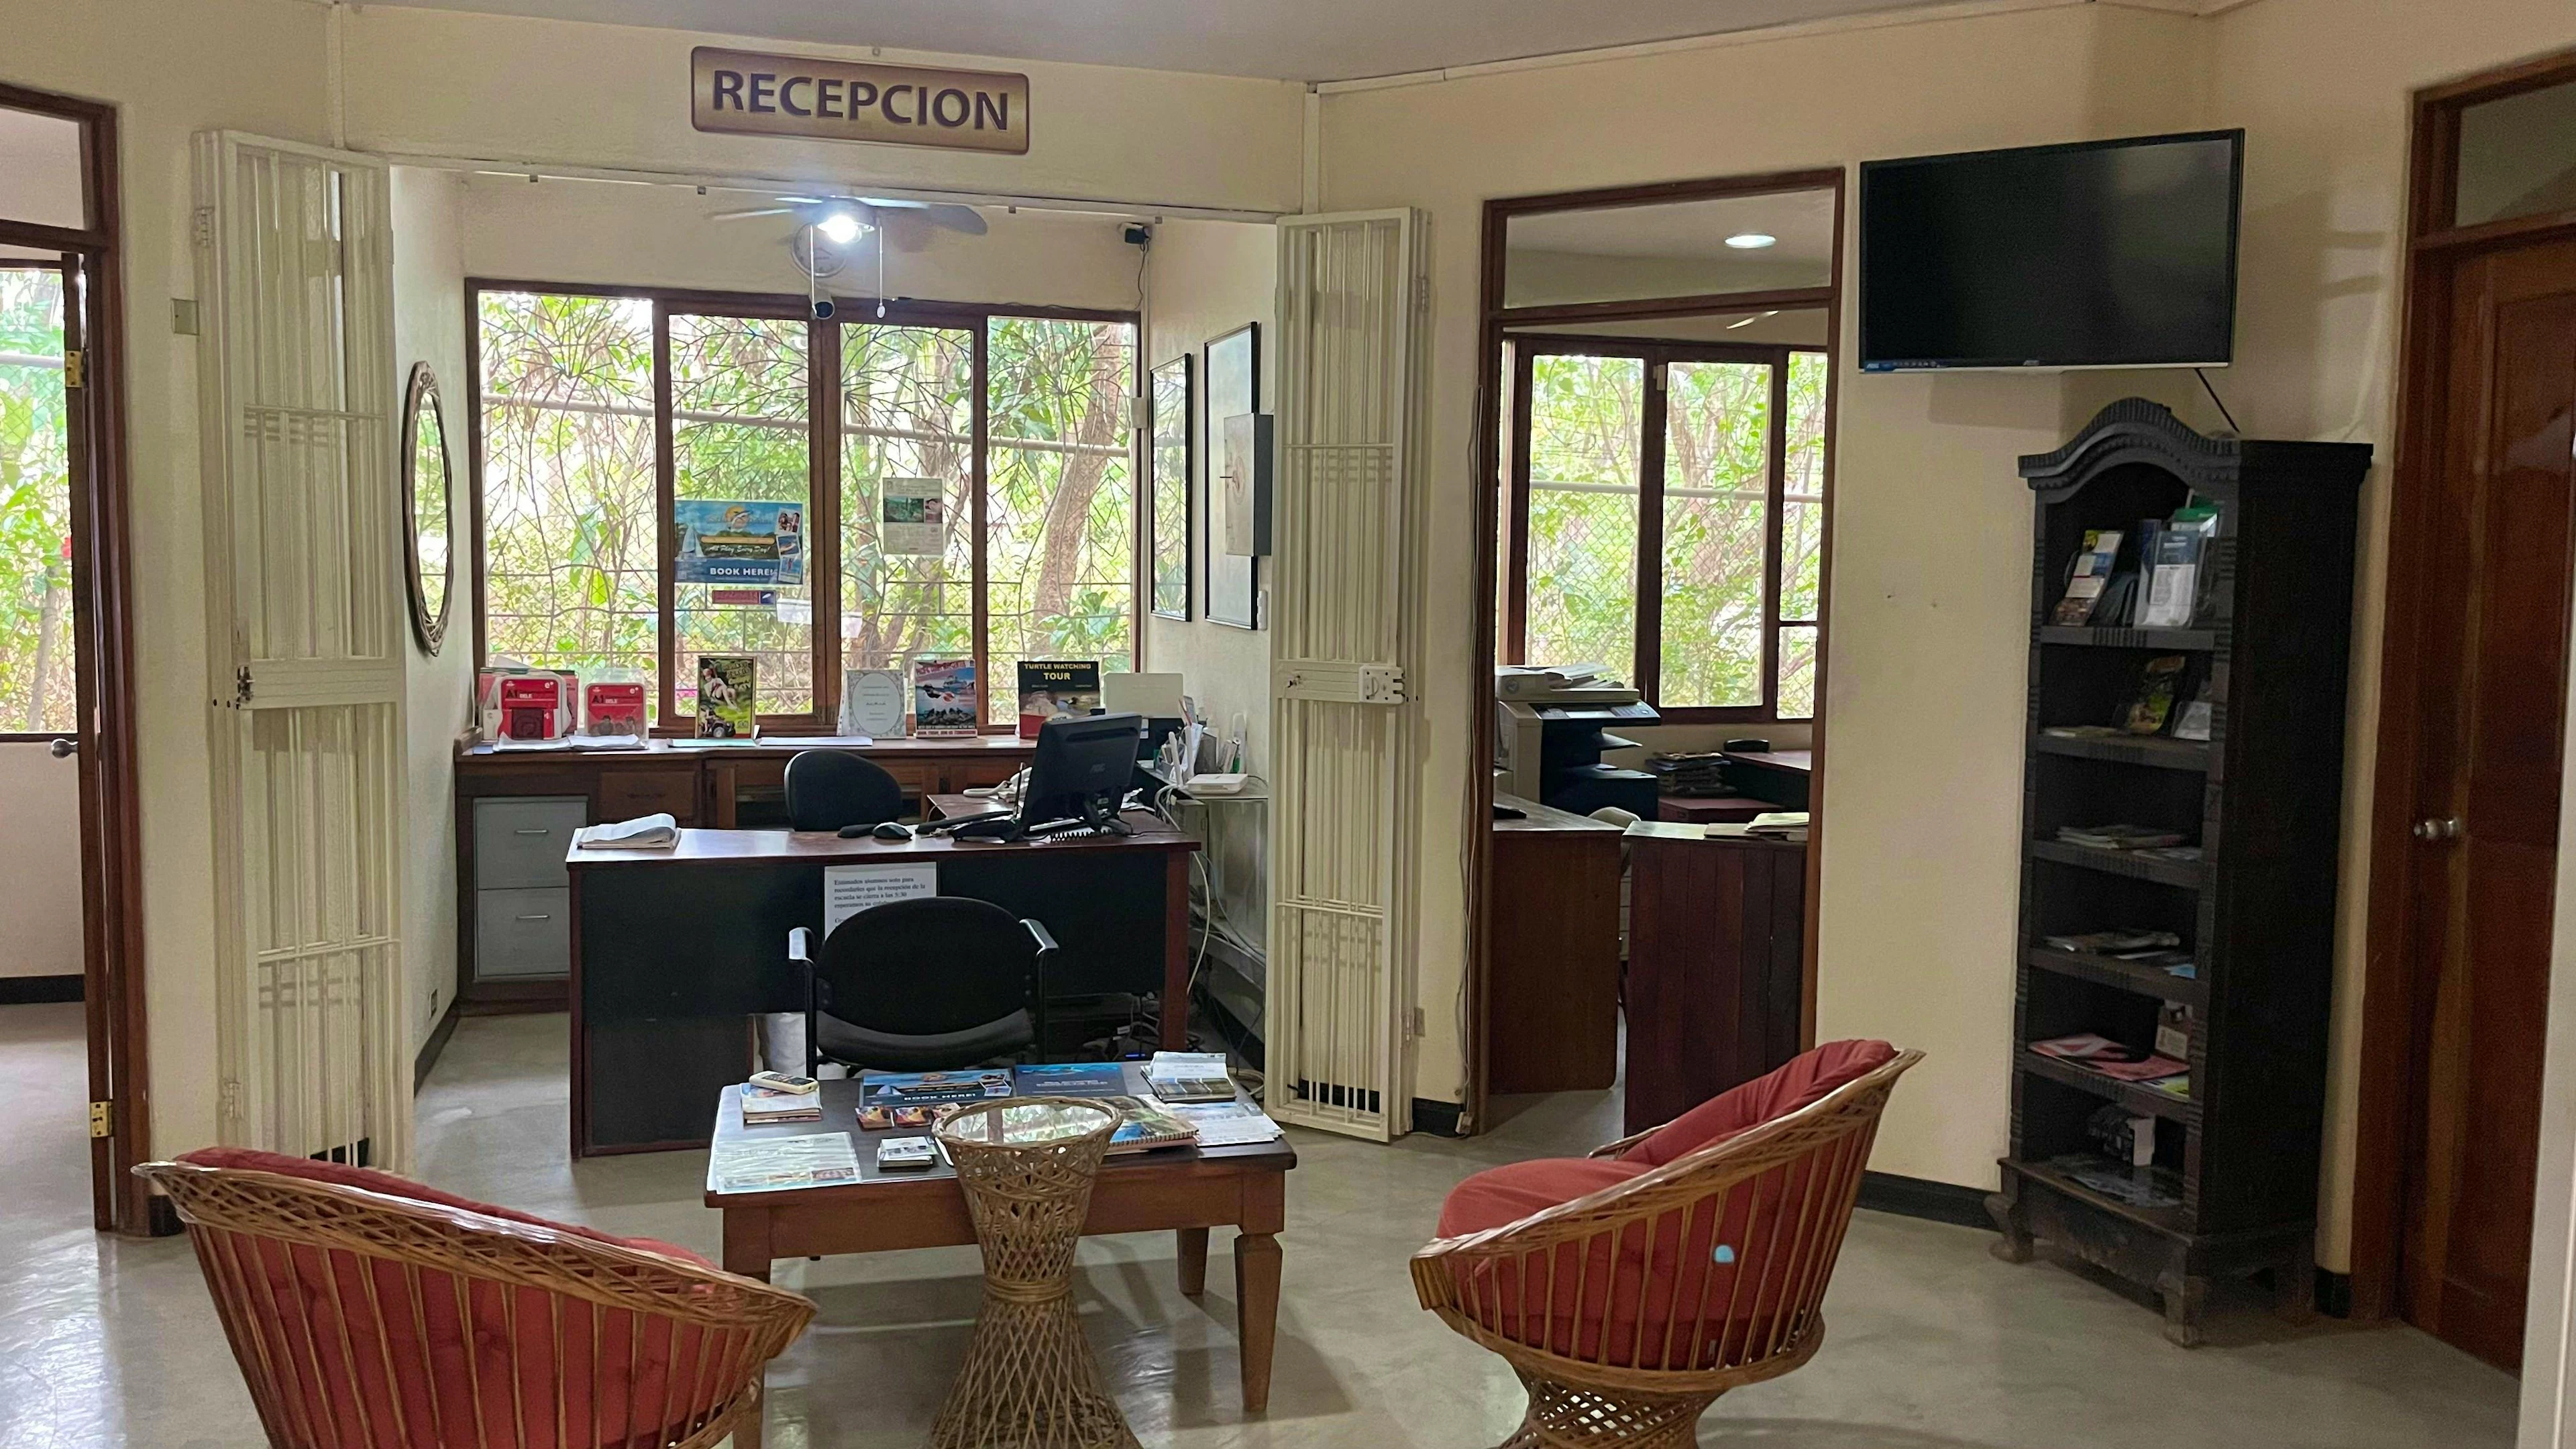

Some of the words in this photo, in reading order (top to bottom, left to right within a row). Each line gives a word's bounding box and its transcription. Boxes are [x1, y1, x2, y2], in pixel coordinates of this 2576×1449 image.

[713, 69, 1009, 131] RECEPCION
[710, 568, 740, 576] BOOK
[743, 568, 774, 576] HERE!
[1043, 672, 1071, 680] TOUR
